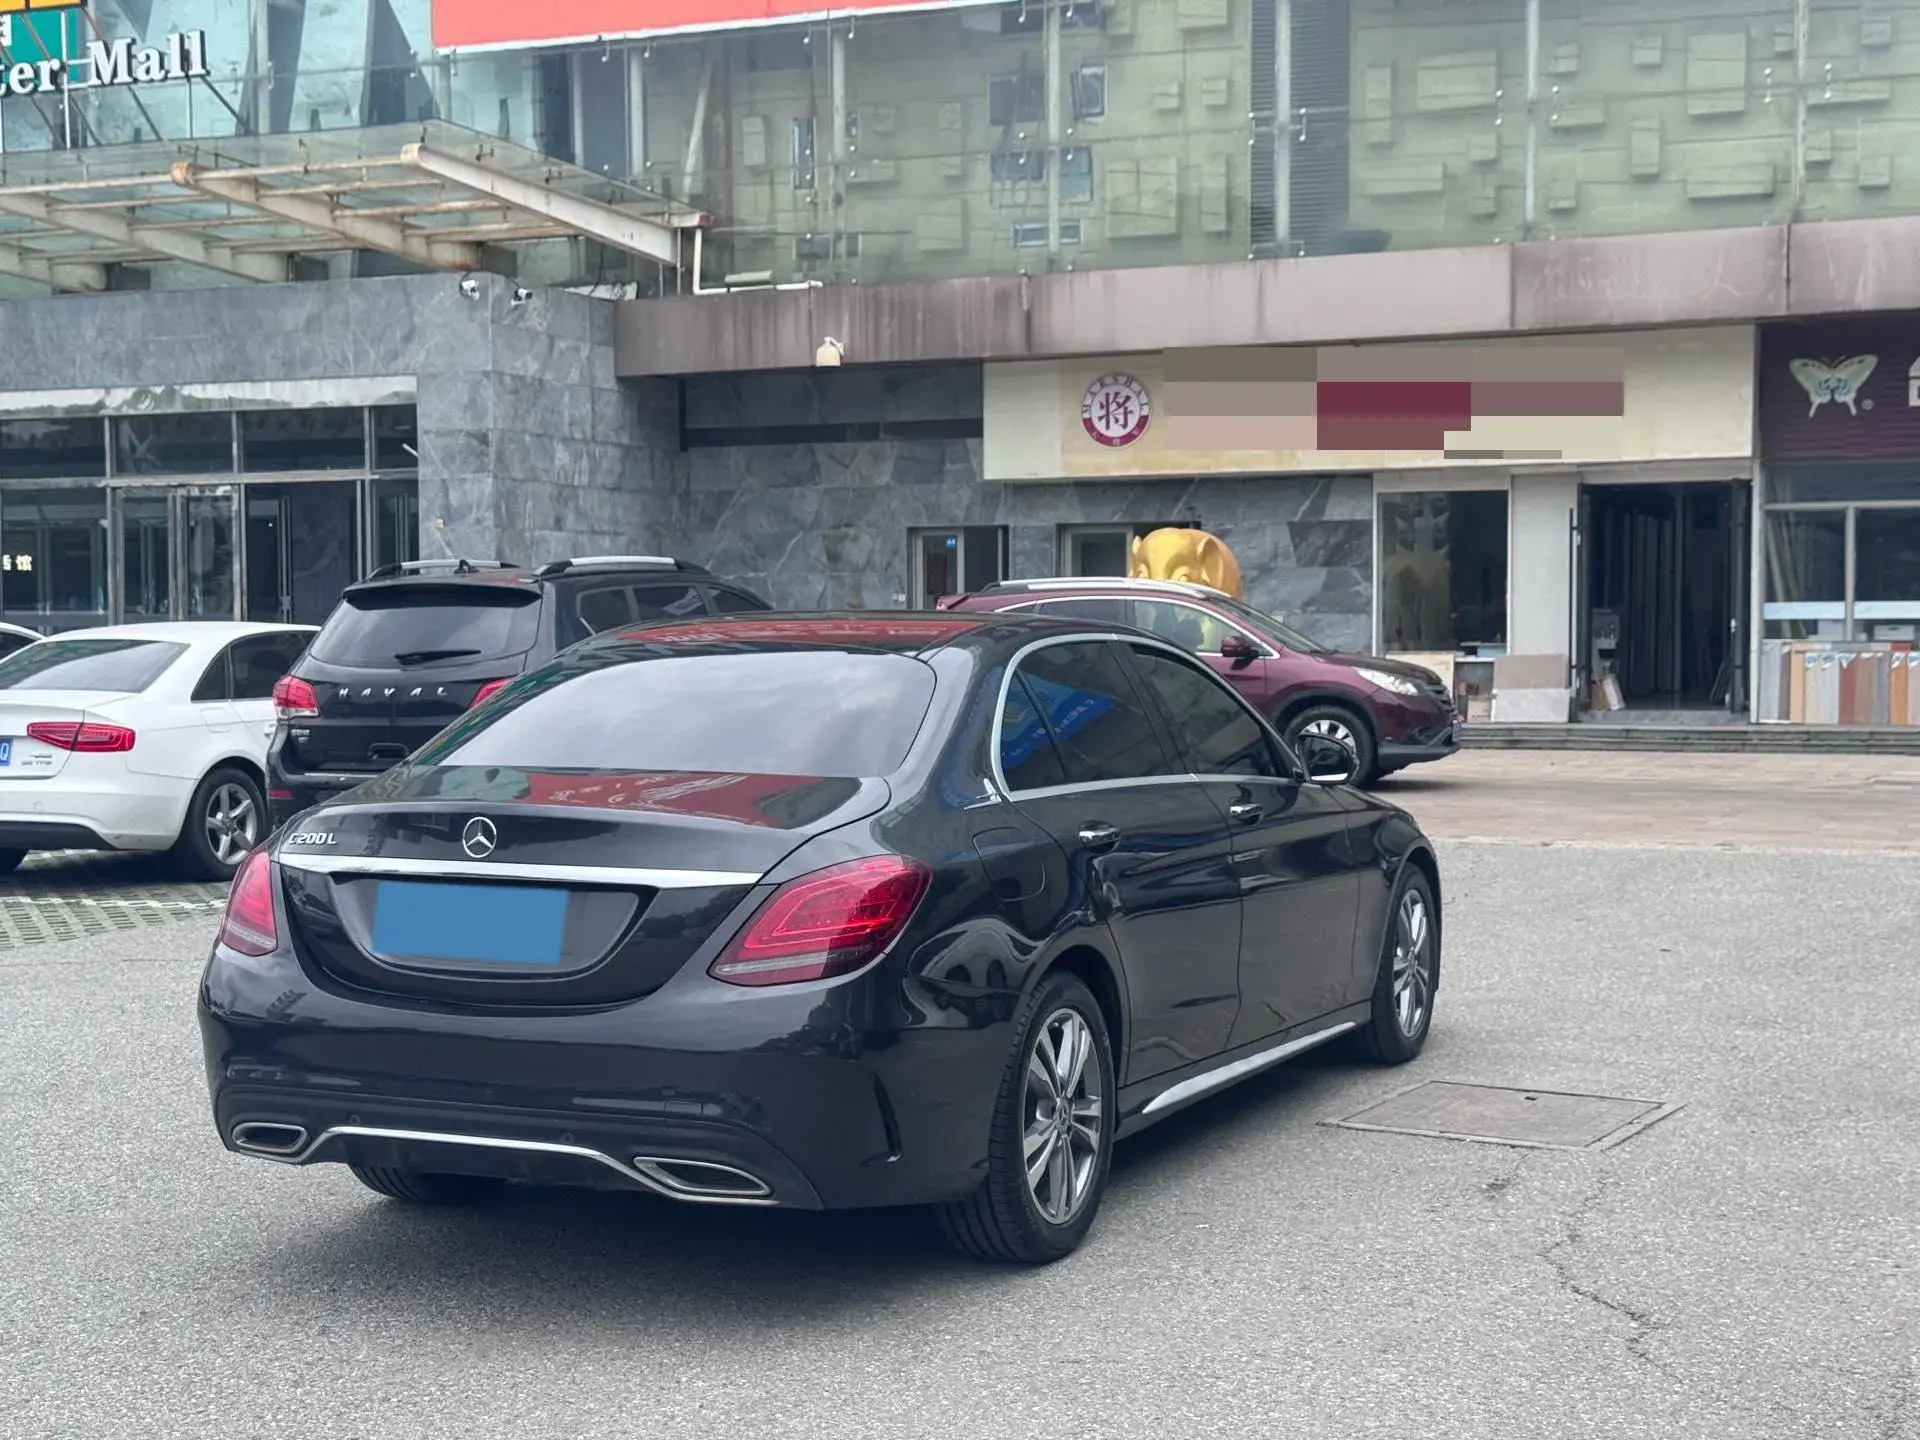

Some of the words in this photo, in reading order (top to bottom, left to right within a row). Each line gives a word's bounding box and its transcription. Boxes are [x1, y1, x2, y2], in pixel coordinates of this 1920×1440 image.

[86, 29, 207, 86] Mall
[1098, 391, 1133, 430] 将
[338, 687, 447, 698] HAVAL
